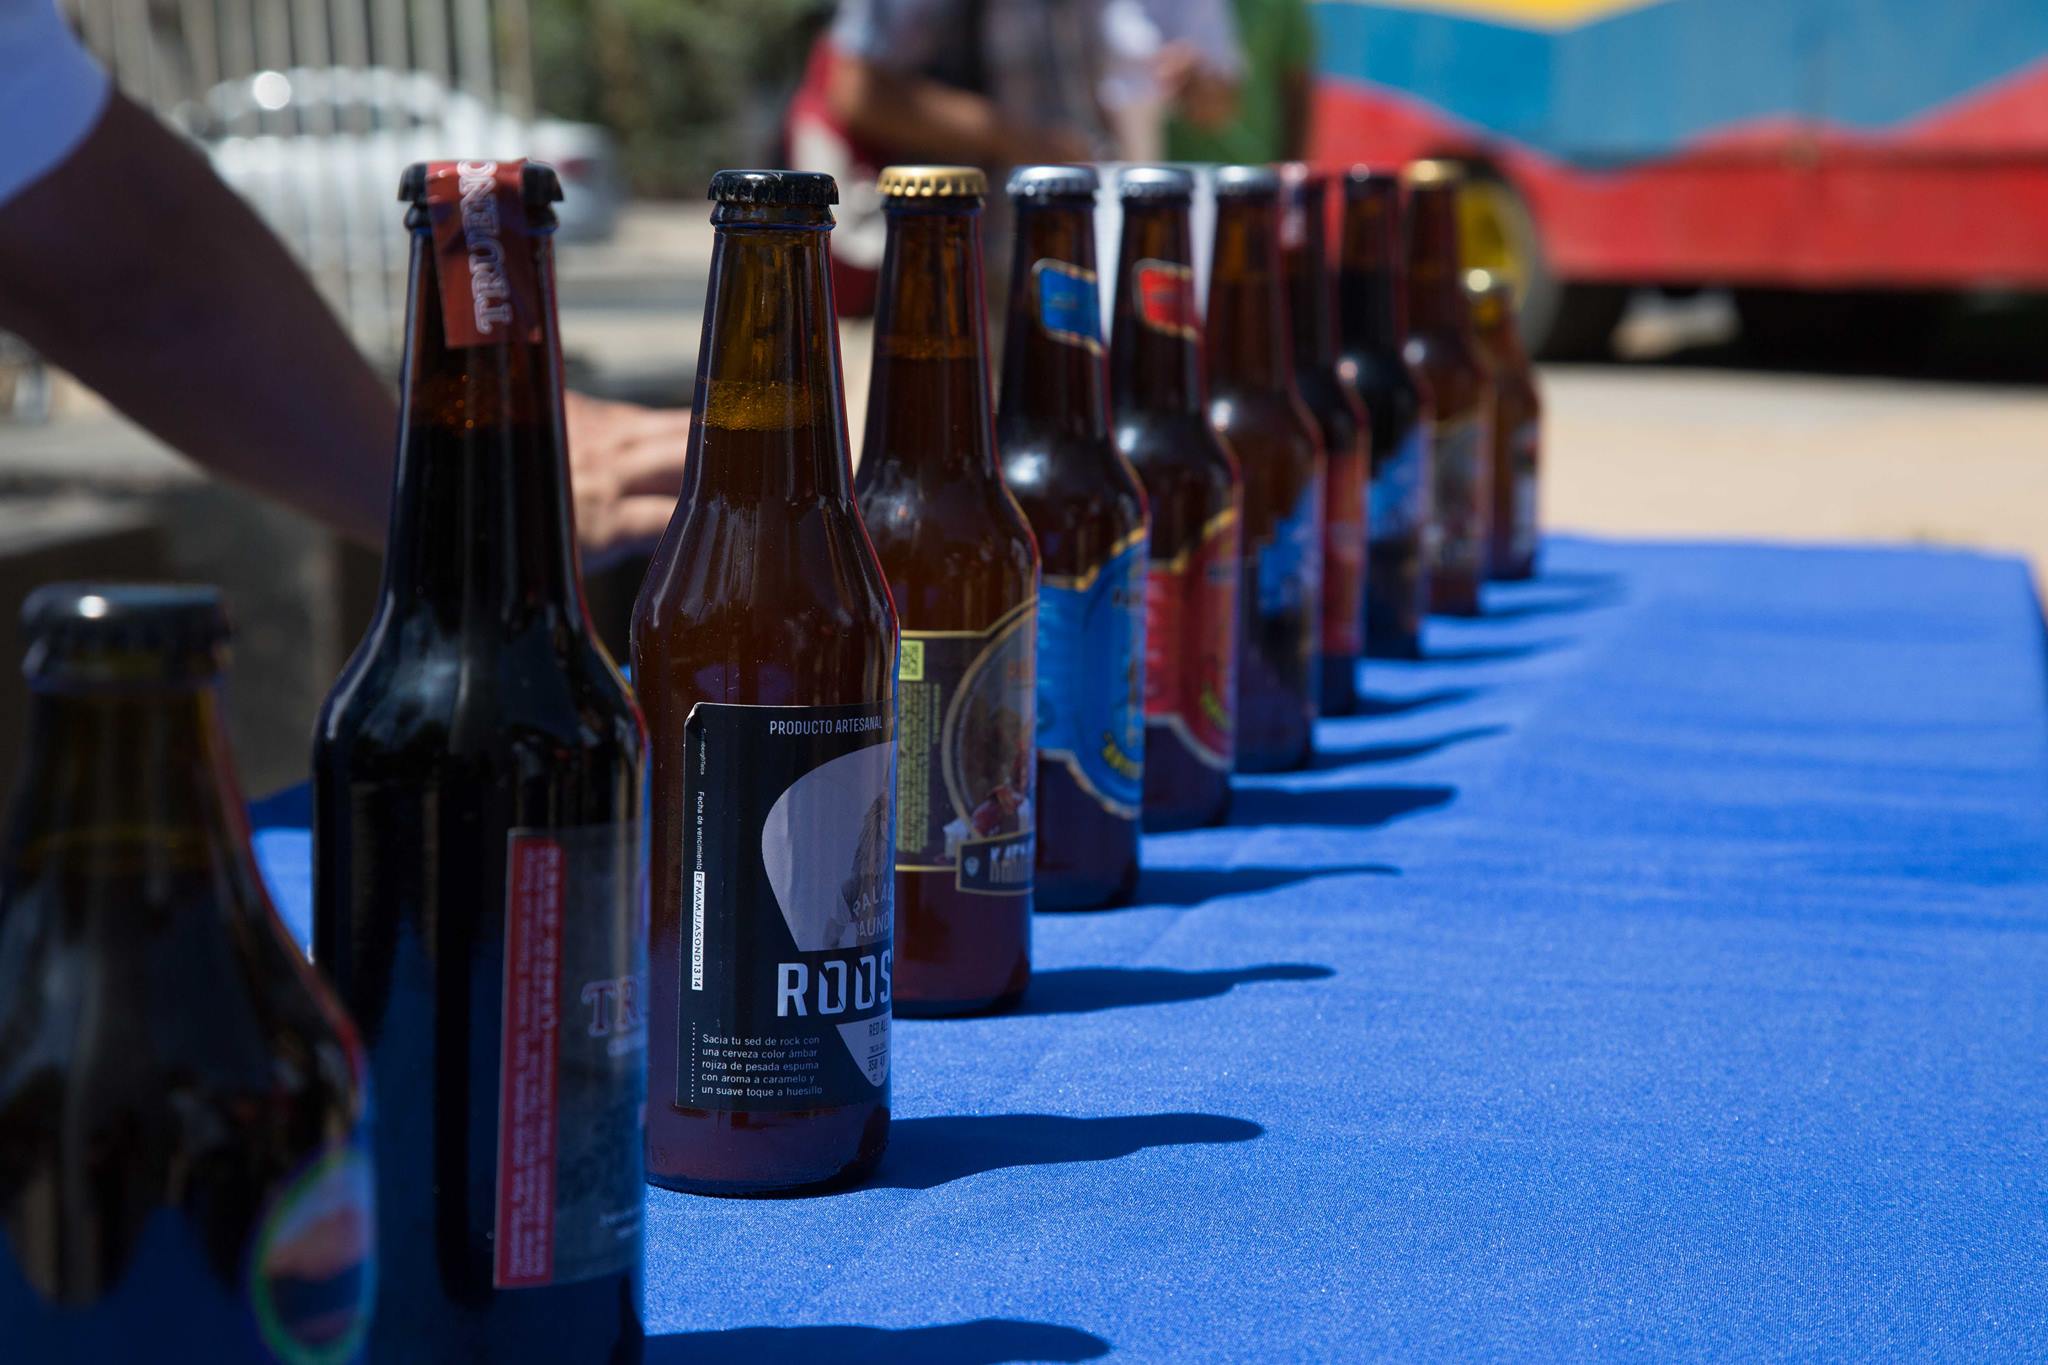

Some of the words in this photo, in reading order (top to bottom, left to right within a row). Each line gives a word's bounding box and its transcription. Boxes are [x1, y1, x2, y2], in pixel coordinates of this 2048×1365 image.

[769, 720, 833, 735] PRODUCTO
[835, 715, 882, 734] ARTESANAL
[697, 791, 705, 814] Fecha
[696, 815, 704, 825] de
[696, 826, 704, 871] vencimiento
[776, 948, 892, 1017] ROOS
[580, 975, 644, 1038] TR
[702, 1033, 728, 1045] Sacia
[731, 1036, 741, 1045] tu
[744, 1037, 762, 1046] sed
[765, 1037, 777, 1046] de
[779, 1036, 801, 1046] rock
[803, 1036, 820, 1045] con
[702, 1048, 719, 1057] una
[722, 1049, 759, 1059] cerveza
[761, 1049, 785, 1059] color
[730, 1061, 743, 1070] de
[745, 1062, 780, 1073] pesada
[783, 1061, 819, 1073] espuma
[701, 1073, 718, 1081] con
[721, 1074, 751, 1084] aroma
[763, 1074, 807, 1084] caramelo
[701, 1086, 713, 1094] un
[716, 1087, 744, 1096] suave
[746, 1088, 774, 1098] toque
